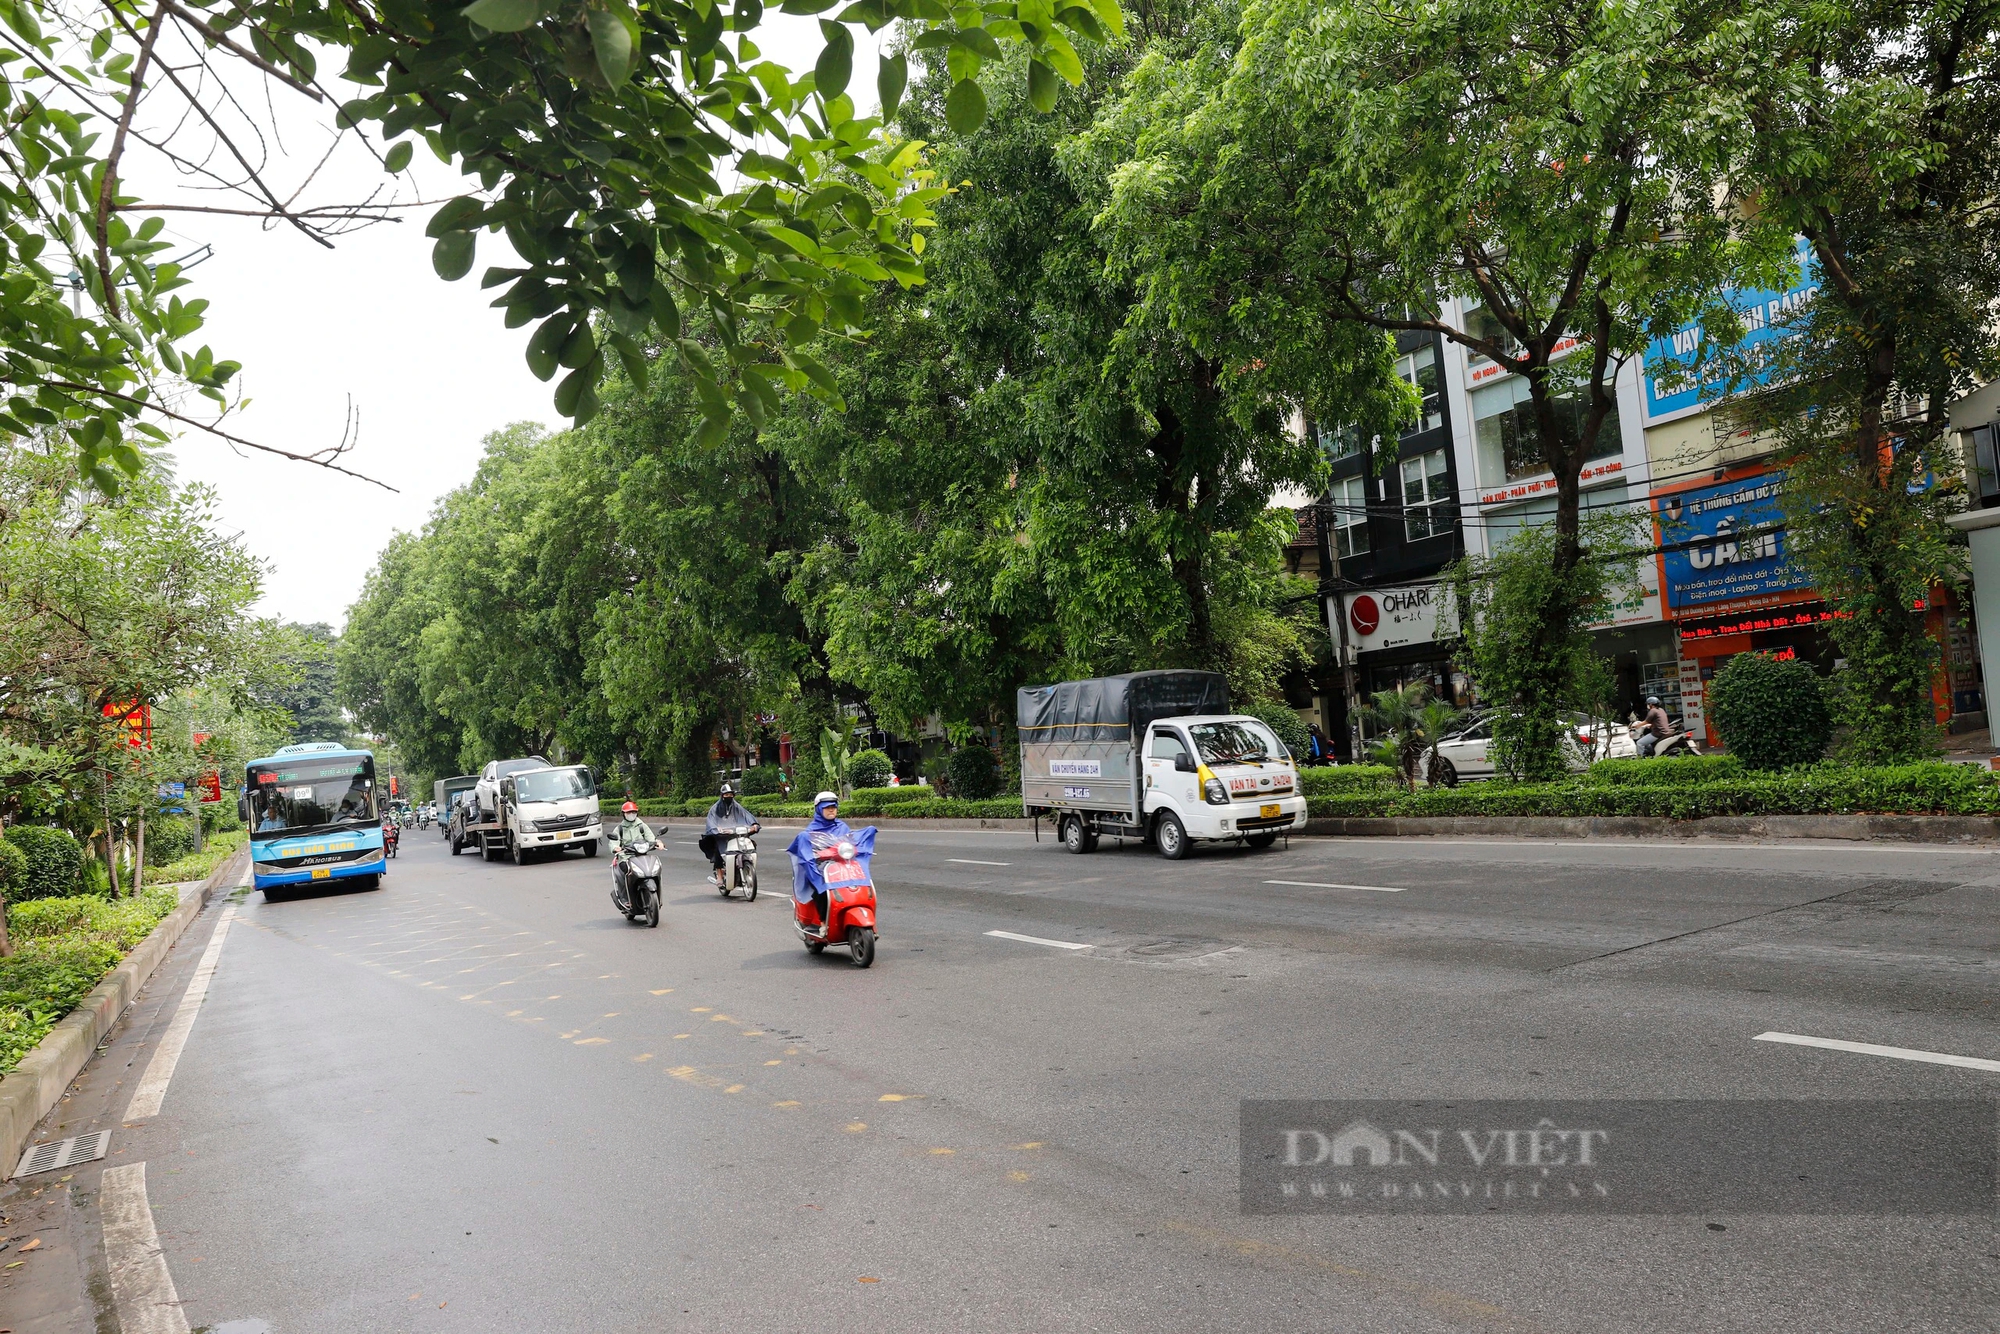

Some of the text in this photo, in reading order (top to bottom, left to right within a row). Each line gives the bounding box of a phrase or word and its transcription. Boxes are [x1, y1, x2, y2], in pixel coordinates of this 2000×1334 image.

[1672, 326, 1699, 356] VAY
[1511, 487, 1526, 498] PHÂN
[1544, 477, 1558, 490] THIẾ
[1605, 462, 1622, 474] CÔNG
[1738, 572, 1753, 582] nhà
[1754, 570, 1768, 580] đất
[1732, 582, 1758, 594] Laptop
[1765, 578, 1787, 588] Trang
[1788, 575, 1803, 584] ức
[1719, 625, 1738, 634] Trao
[1754, 619, 1771, 629] Nhà
[1090, 765, 1099, 774] 24H
[1229, 777, 1245, 793] VẬN
[1245, 775, 1257, 790] TẢI
[299, 855, 342, 866] HANOIBUS
